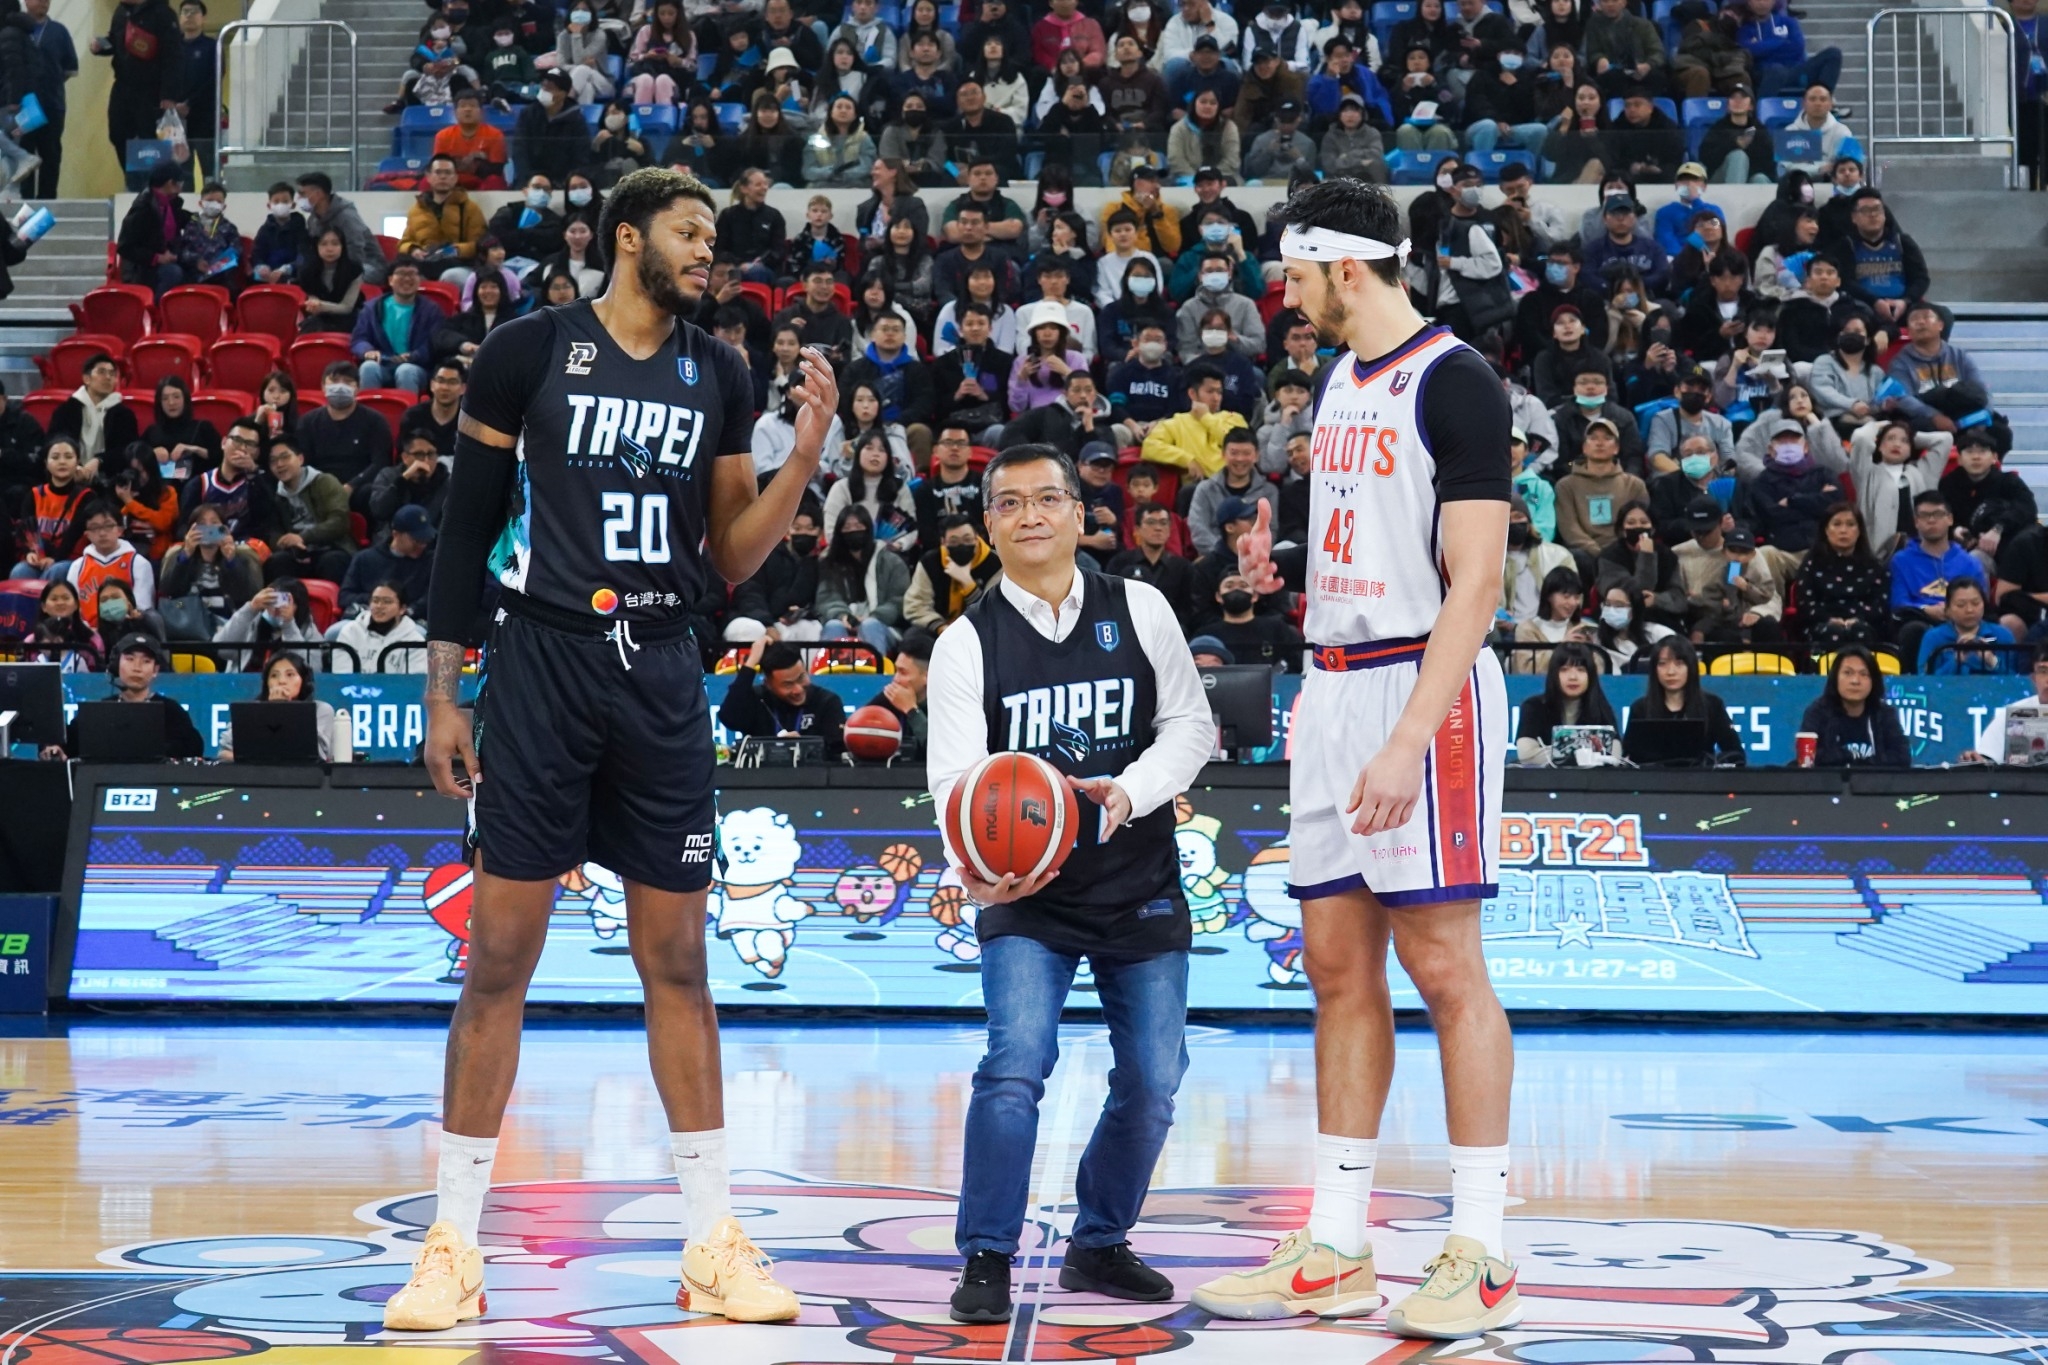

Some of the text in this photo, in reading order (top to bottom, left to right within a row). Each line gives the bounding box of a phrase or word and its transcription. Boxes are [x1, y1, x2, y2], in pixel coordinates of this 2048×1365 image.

[684, 360, 693, 378] B
[1395, 373, 1408, 389] P
[567, 394, 705, 469] TAIPEI
[1311, 424, 1399, 478] PILOTS
[568, 460, 614, 468] FUBON
[602, 491, 671, 564] 20
[1323, 508, 1355, 565] 42
[1102, 625, 1112, 643] B
[352, 704, 424, 748] BRA
[1002, 677, 1135, 751] TAIPEI
[1450, 734, 1464, 790] PILOTS
[111, 794, 151, 806] BT21
[986, 782, 1001, 842] molten
[1455, 832, 1463, 846] P
[1499, 815, 1646, 863] BT21
[1608, 1113, 2048, 1136] SK
